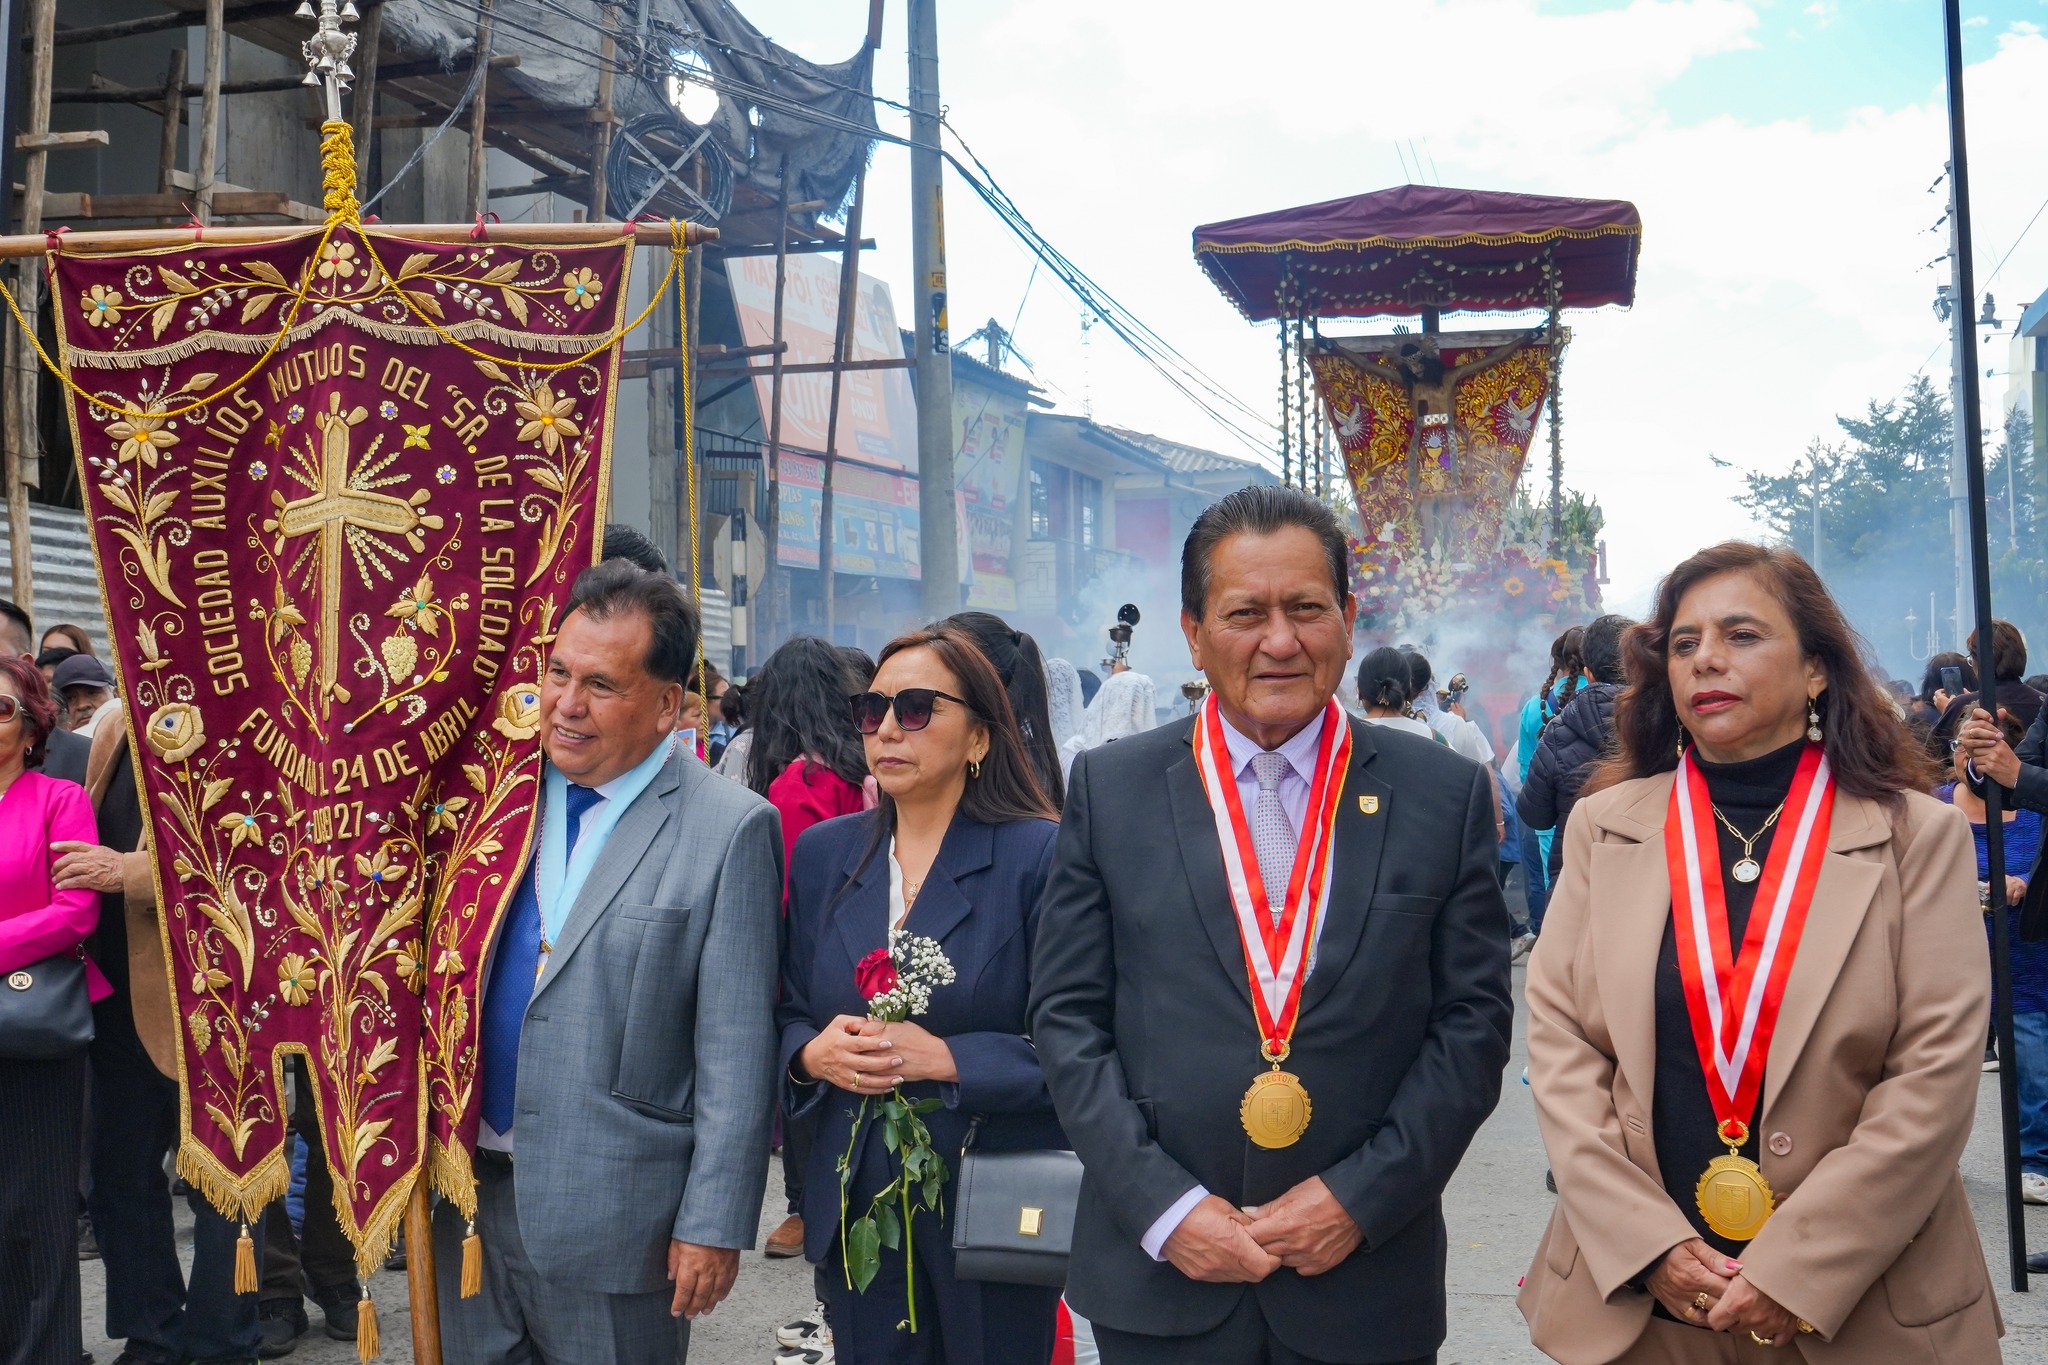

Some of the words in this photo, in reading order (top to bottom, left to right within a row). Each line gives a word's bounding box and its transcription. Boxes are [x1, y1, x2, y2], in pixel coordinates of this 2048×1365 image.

[267, 342, 367, 402] MUTUOS
[380, 356, 430, 410] DEL
[189, 385, 265, 531] AUXILIOS
[474, 453, 514, 489] DE
[478, 497, 516, 534] LA
[193, 548, 250, 697] SOCIEDAD
[332, 754, 370, 796] 24
[372, 739, 419, 784] DE
[418, 694, 480, 766] ABRIL
[1259, 1073, 1294, 1085] RECTOR
